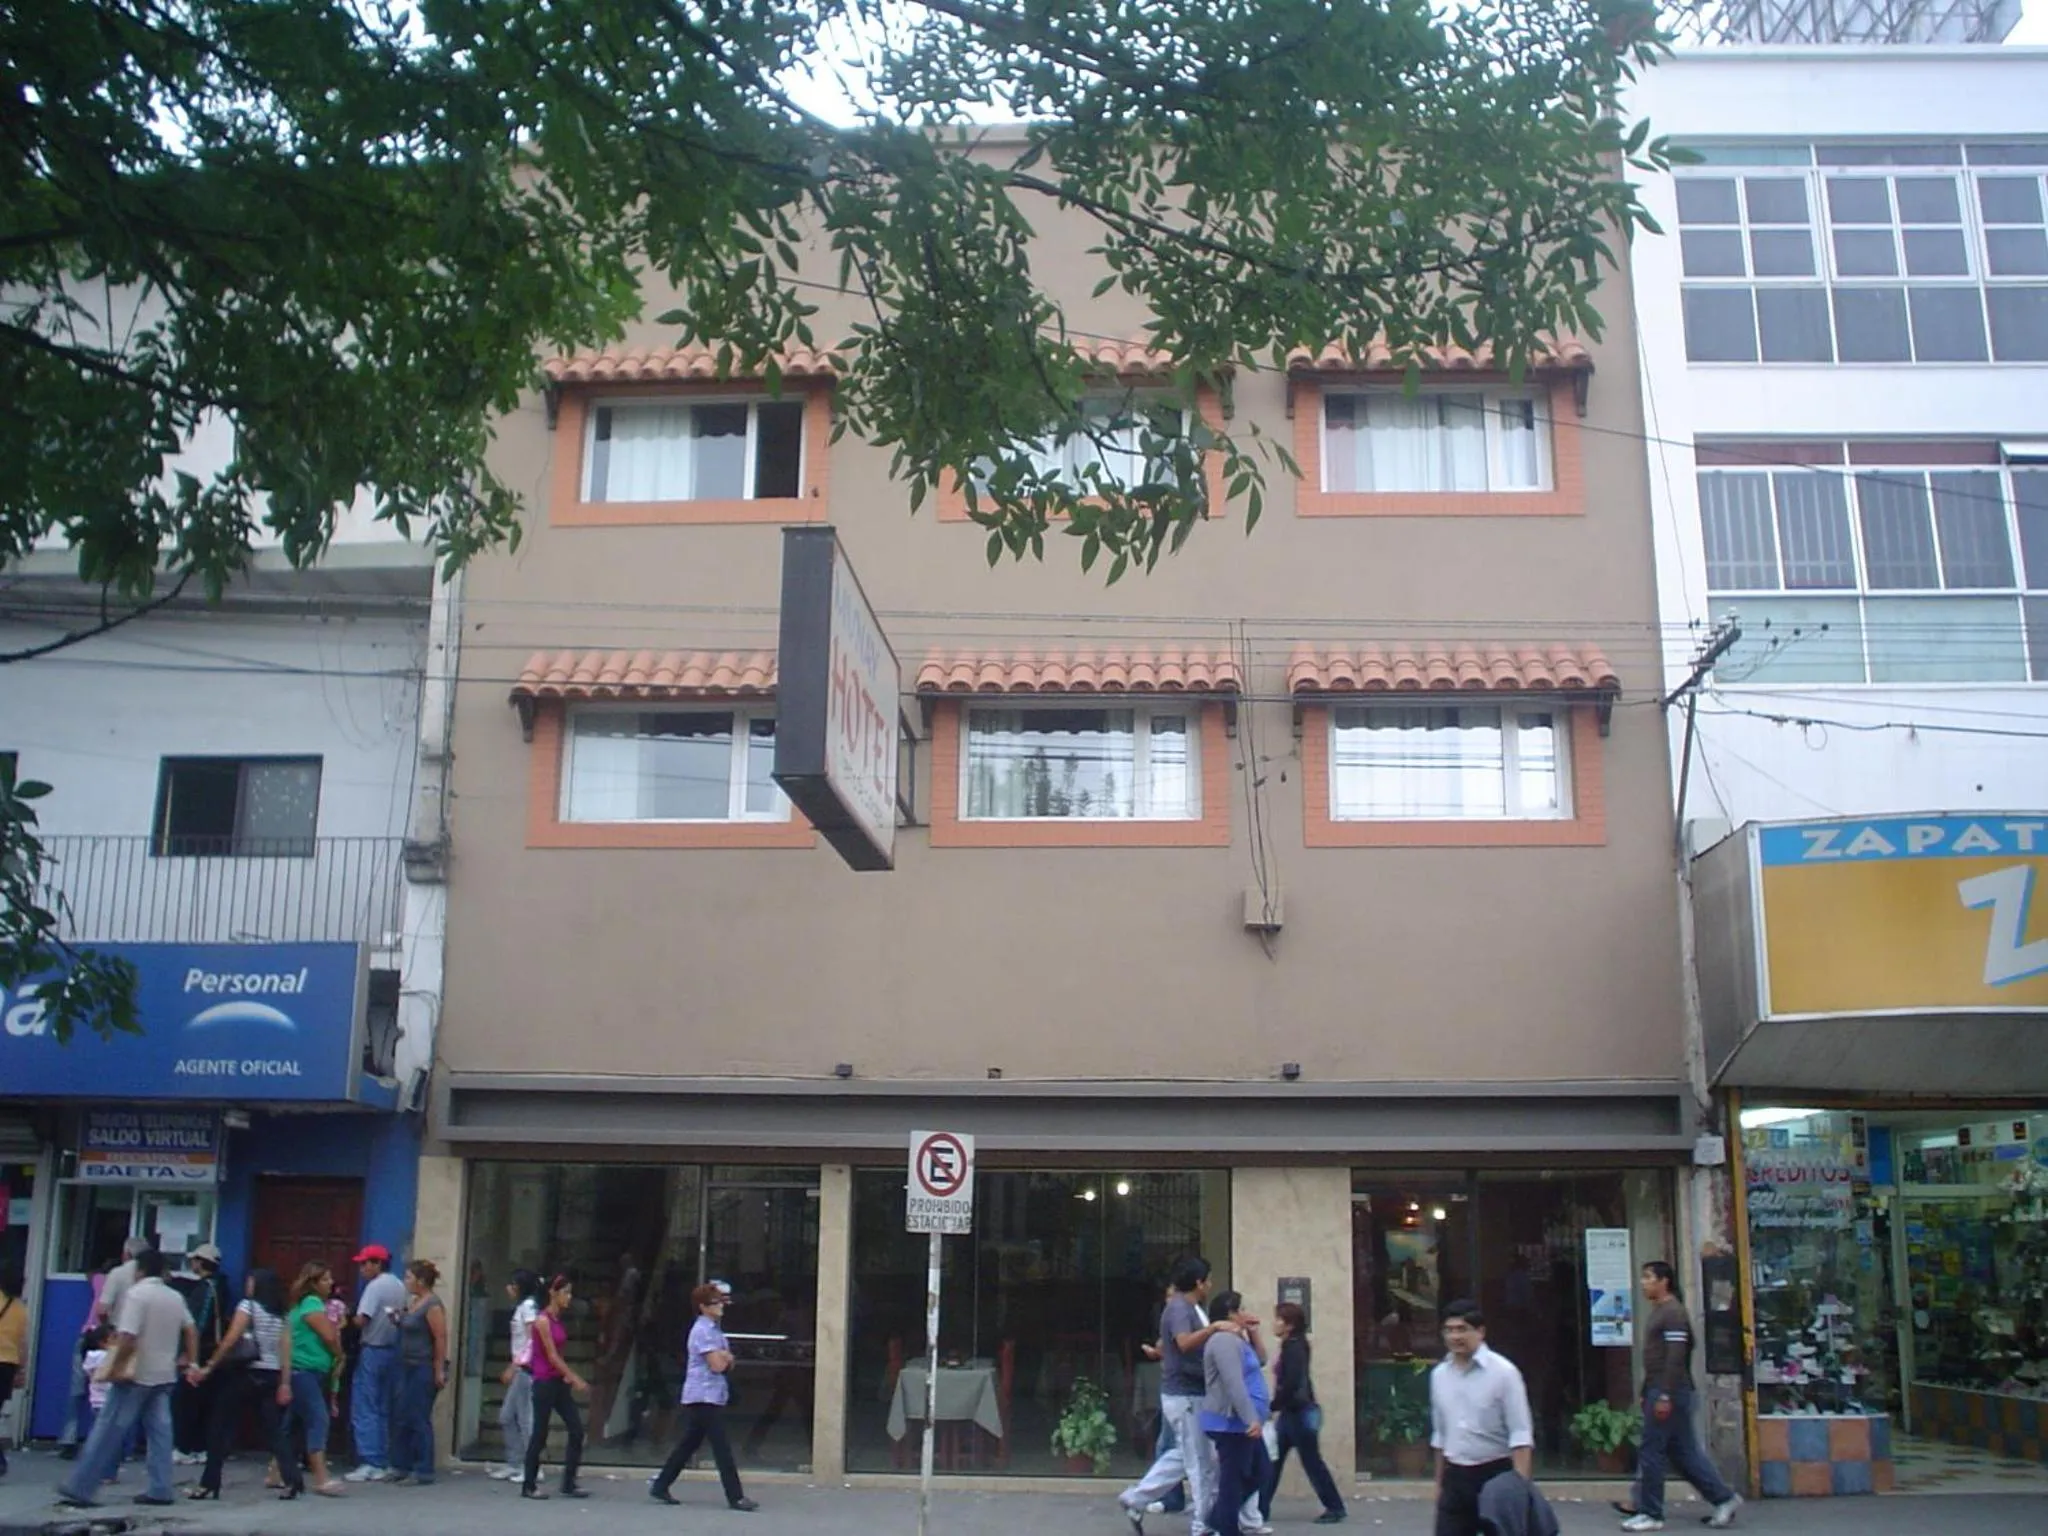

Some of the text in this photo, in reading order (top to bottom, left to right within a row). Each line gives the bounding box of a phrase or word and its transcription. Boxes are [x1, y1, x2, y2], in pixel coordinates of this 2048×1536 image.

[831, 635, 893, 808] HOTEL
[1802, 823, 2045, 859] ZAPAT
[184, 966, 308, 994] Personal
[174, 1059, 302, 1076] AGENTE OFICIAL
[88, 1128, 210, 1147] SALDO VIRTUAL
[909, 1197, 970, 1214] PROHIBIDO
